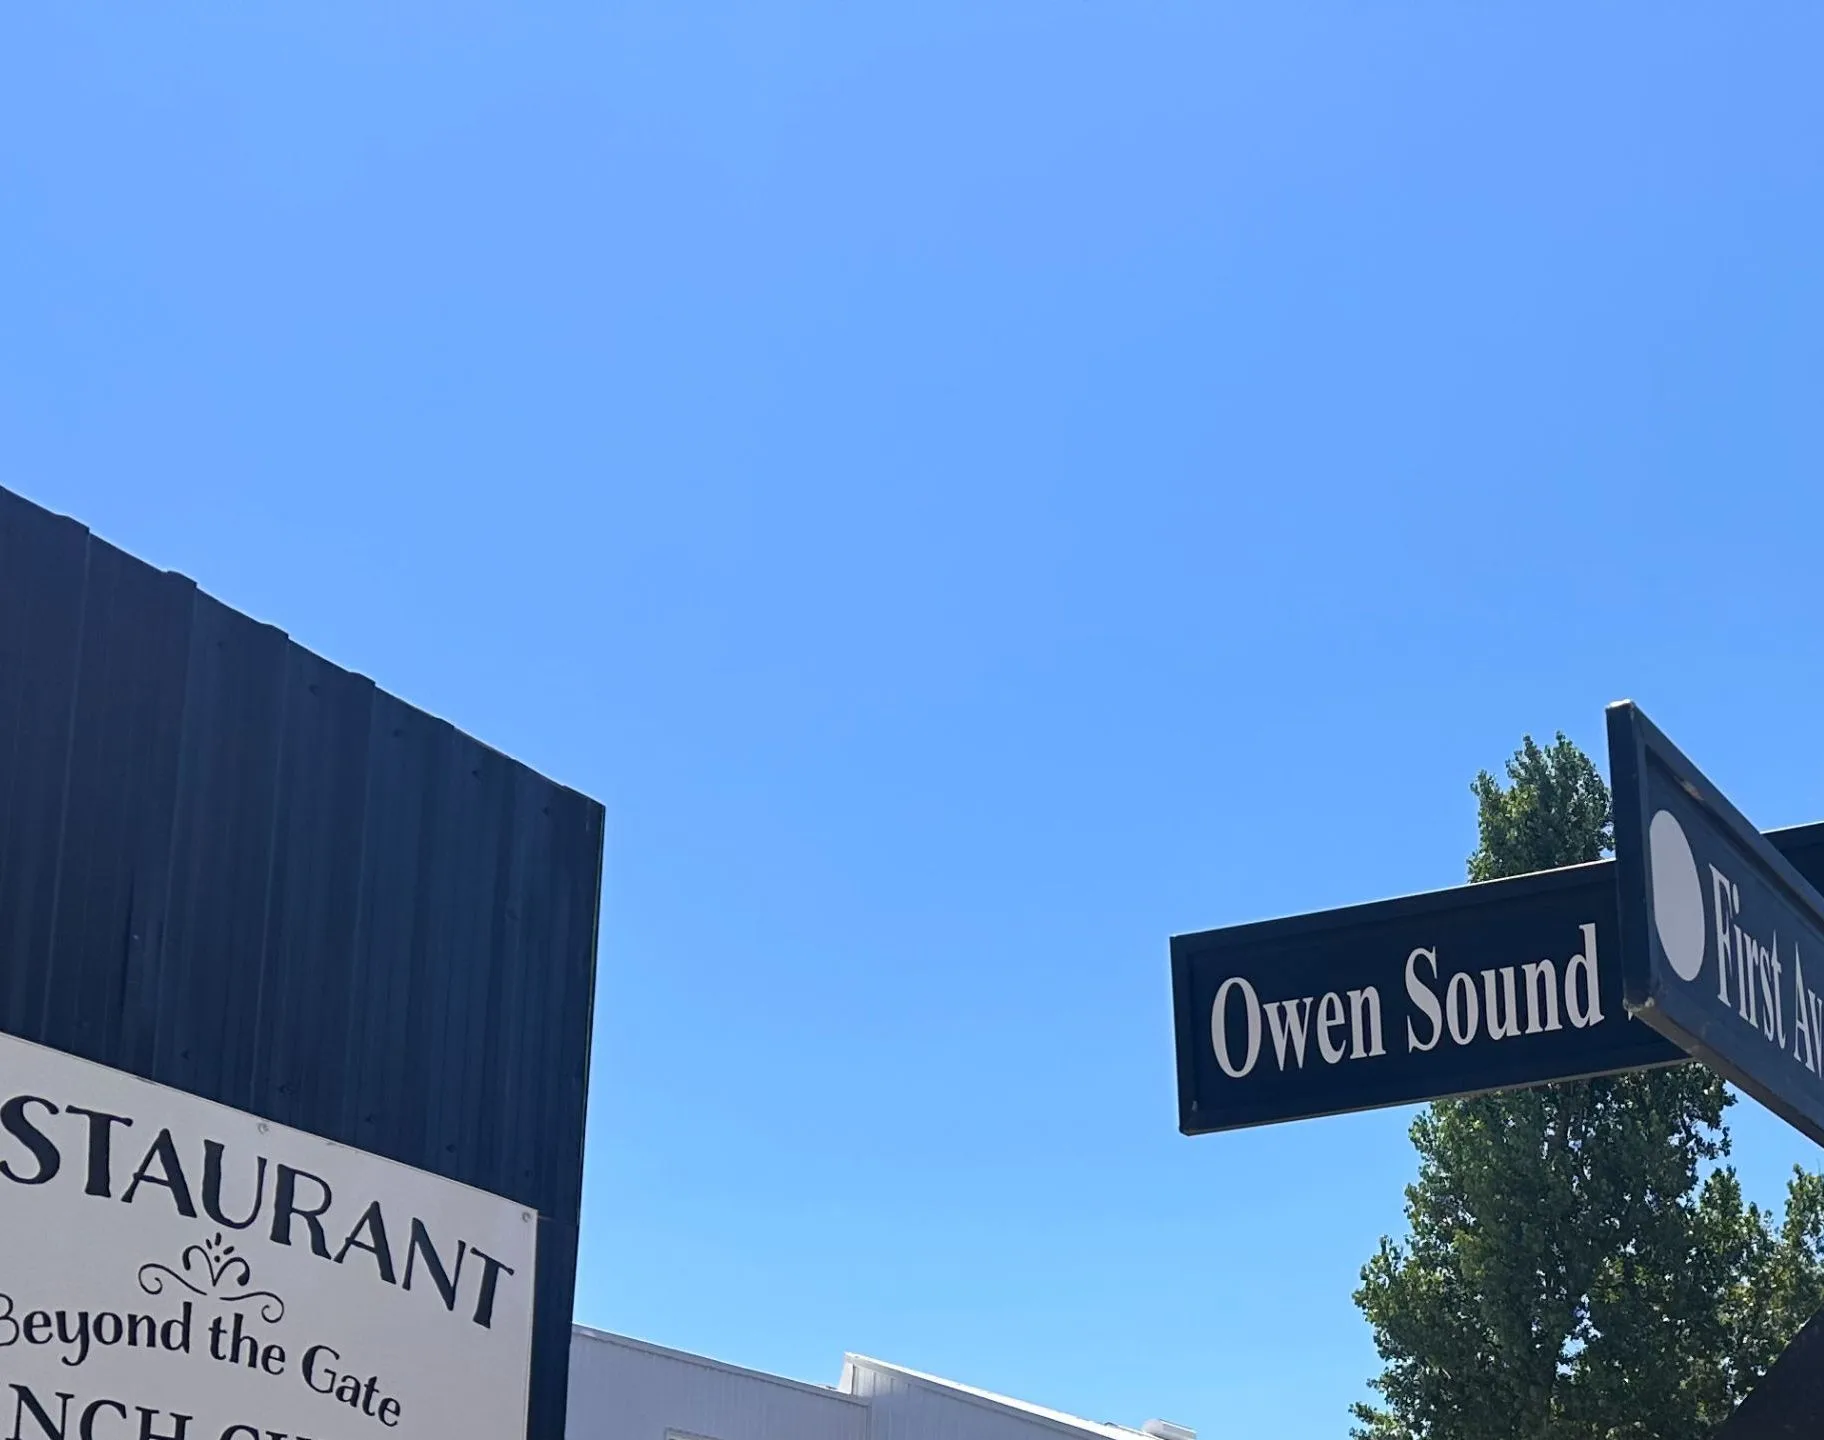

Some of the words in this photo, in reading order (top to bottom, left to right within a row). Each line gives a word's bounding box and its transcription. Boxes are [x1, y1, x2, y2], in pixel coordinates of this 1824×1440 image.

[1211, 976, 1385, 1078] Owen
[1406, 923, 1604, 1053] Sound
[1709, 863, 1786, 1050] First
[0, 1095, 514, 1329] STAURANT
[209, 1313, 286, 1376] the
[302, 1345, 401, 1427] Gate
